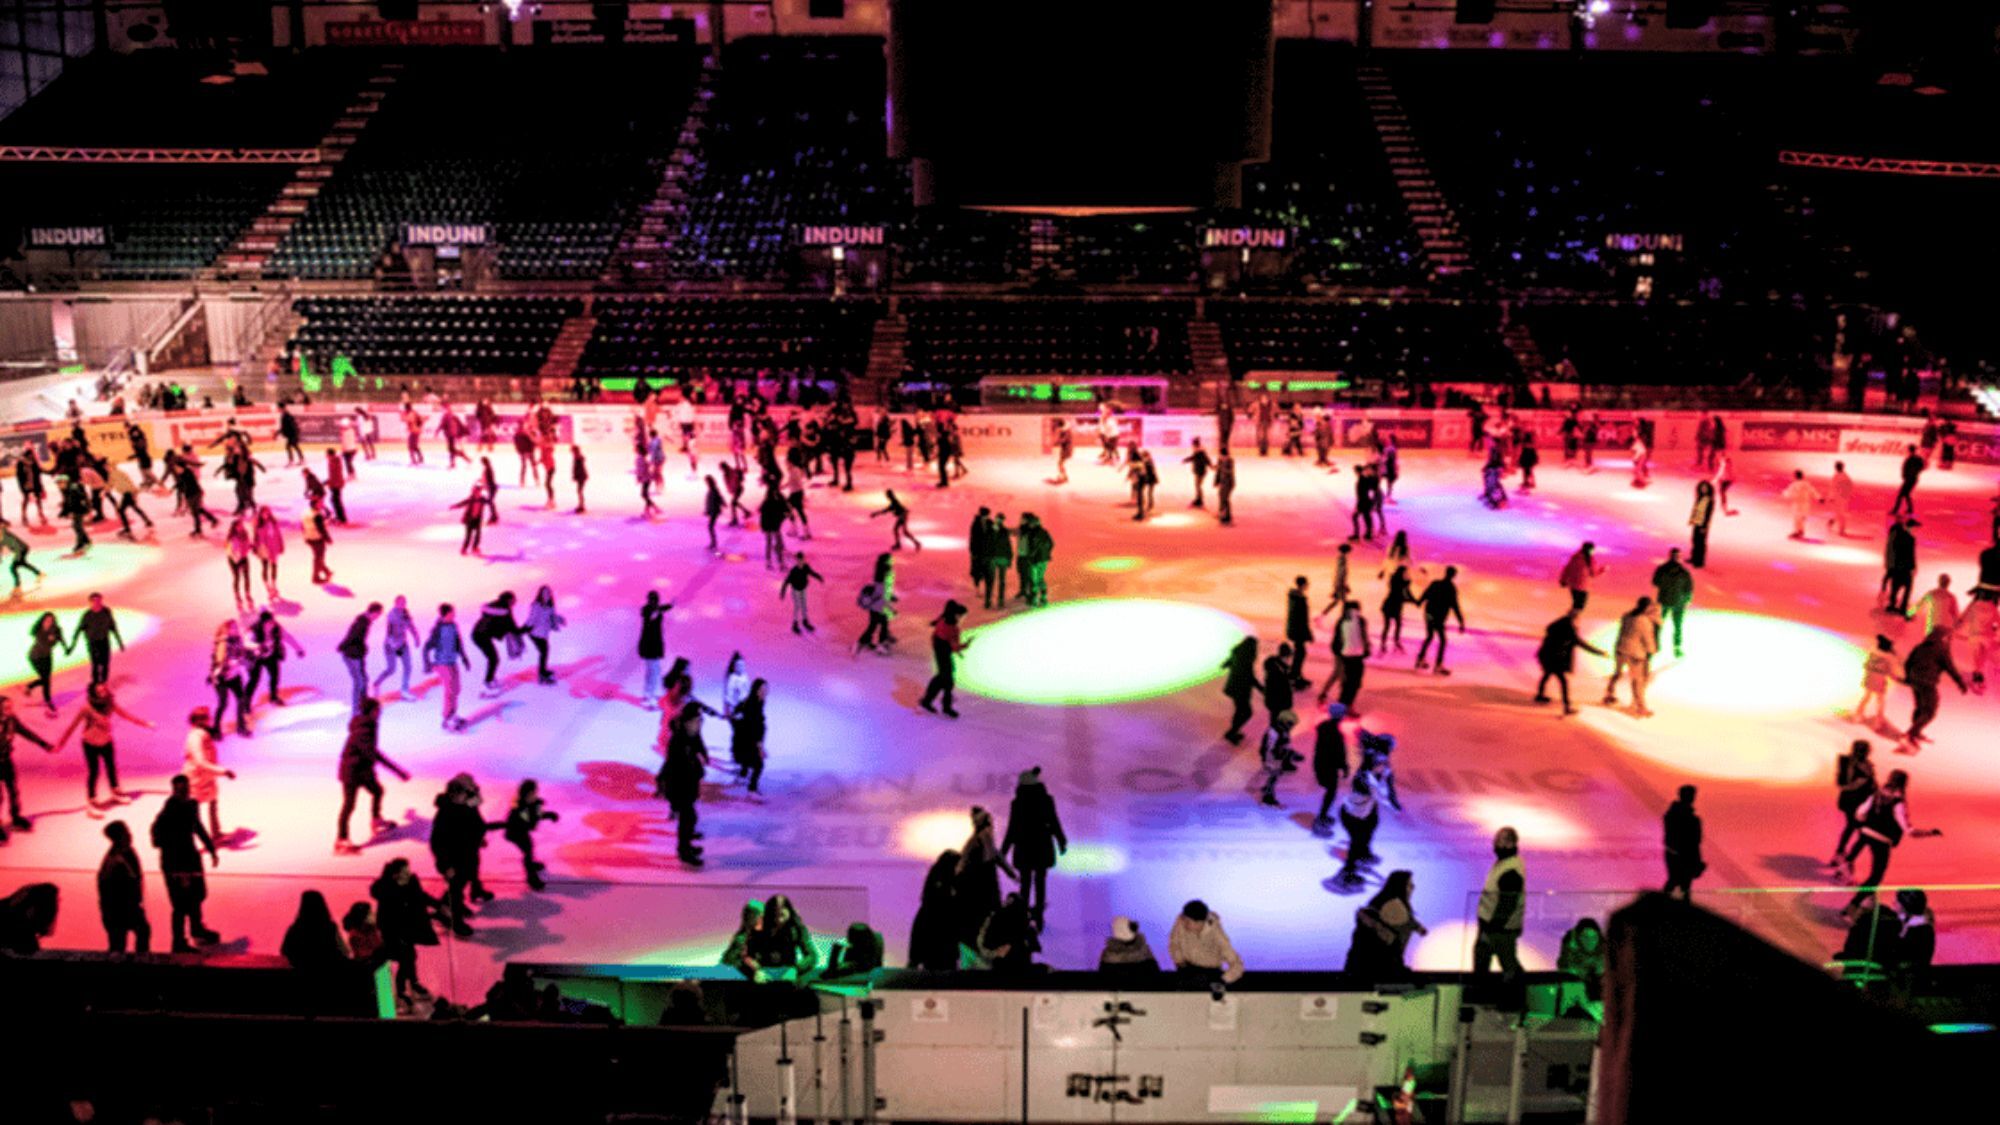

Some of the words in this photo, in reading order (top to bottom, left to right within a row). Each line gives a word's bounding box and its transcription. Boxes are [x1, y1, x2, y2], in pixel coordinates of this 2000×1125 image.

[31, 227, 105, 245] INDUNI
[408, 225, 485, 243] INDUNI
[804, 226, 883, 244] INDUNI
[1206, 228, 1286, 247] INDUNI
[1606, 233, 1683, 251] INDUNI
